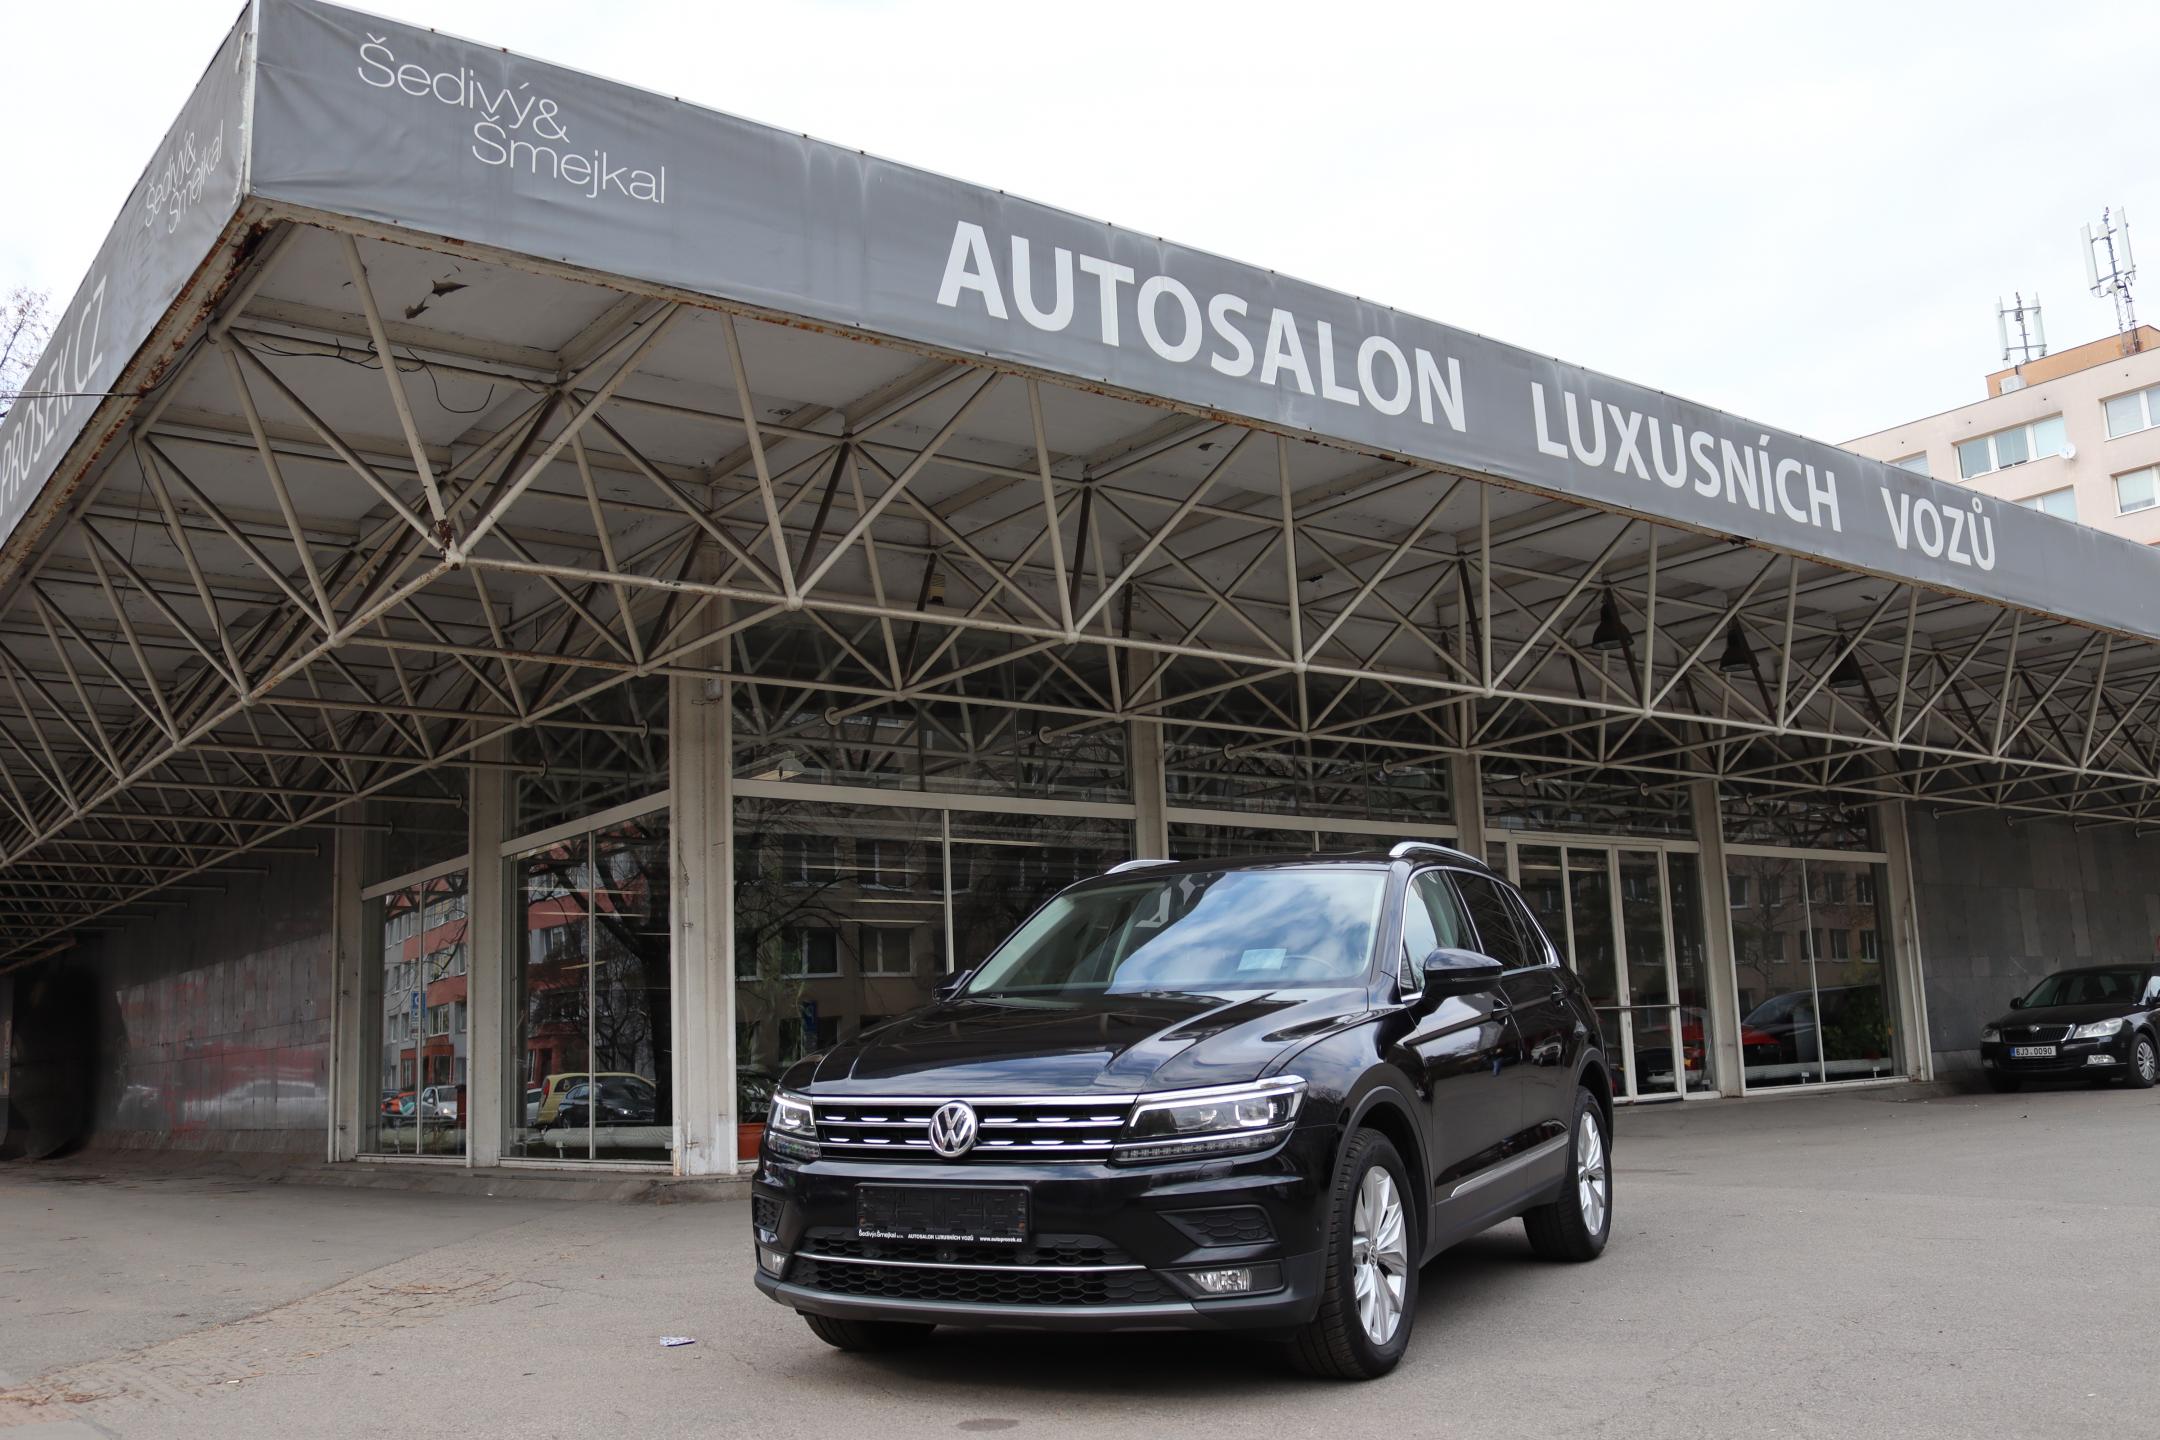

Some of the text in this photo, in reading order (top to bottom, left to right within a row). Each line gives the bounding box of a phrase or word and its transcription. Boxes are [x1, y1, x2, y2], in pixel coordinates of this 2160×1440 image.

[357, 32, 570, 143] Šedivý&
[168, 119, 224, 234] Šmejkal
[472, 111, 665, 204] Šmejkal
[936, 220, 1997, 571] AUTOSALON LUXUSNÍCH VOZŮ
